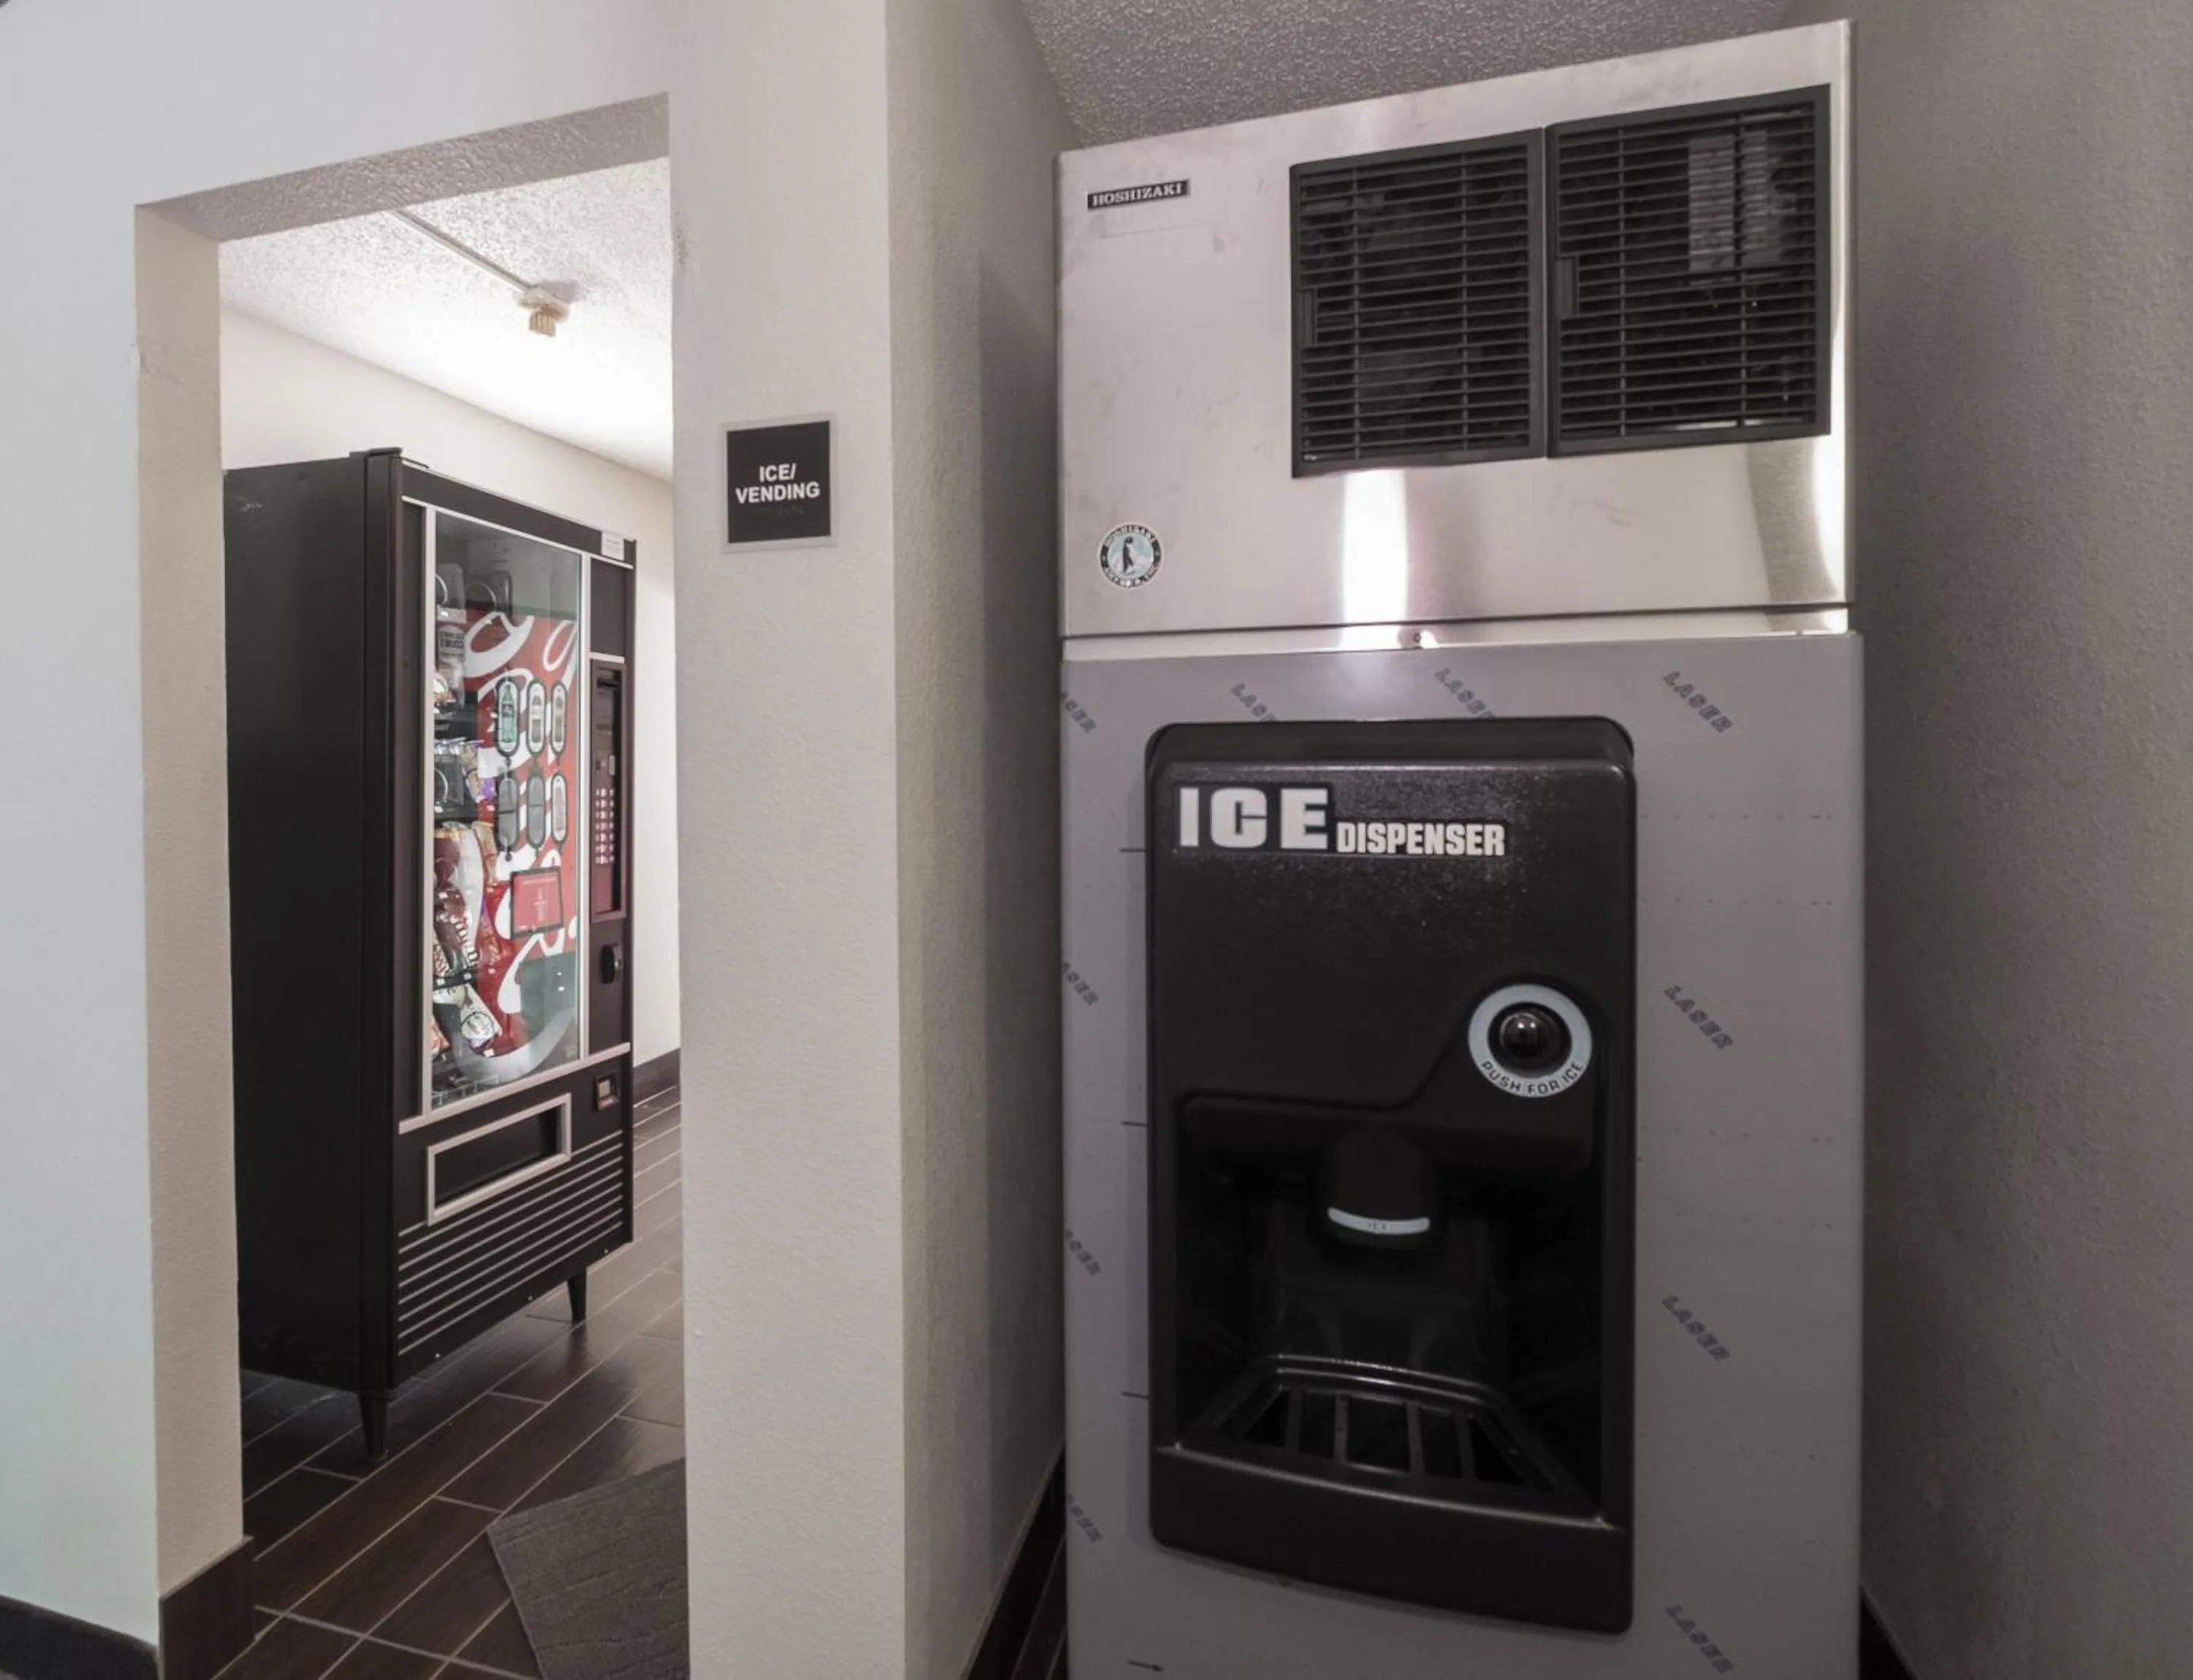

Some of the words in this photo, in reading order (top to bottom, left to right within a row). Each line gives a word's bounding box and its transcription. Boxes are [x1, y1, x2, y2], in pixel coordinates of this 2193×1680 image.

[1092, 183, 1182, 206] HOSHIZAKI
[760, 463, 797, 483] ICE/
[735, 481, 820, 504] VENDING
[1663, 671, 1732, 733] LASER
[1179, 787, 1328, 849] ICE
[1336, 822, 1506, 856] DISPENSER
[1664, 985, 1733, 1050] LASER
[1481, 1060, 1521, 1092] PUSH
[1528, 1080, 1560, 1094] FOR
[1562, 1061, 1583, 1084] ICE
